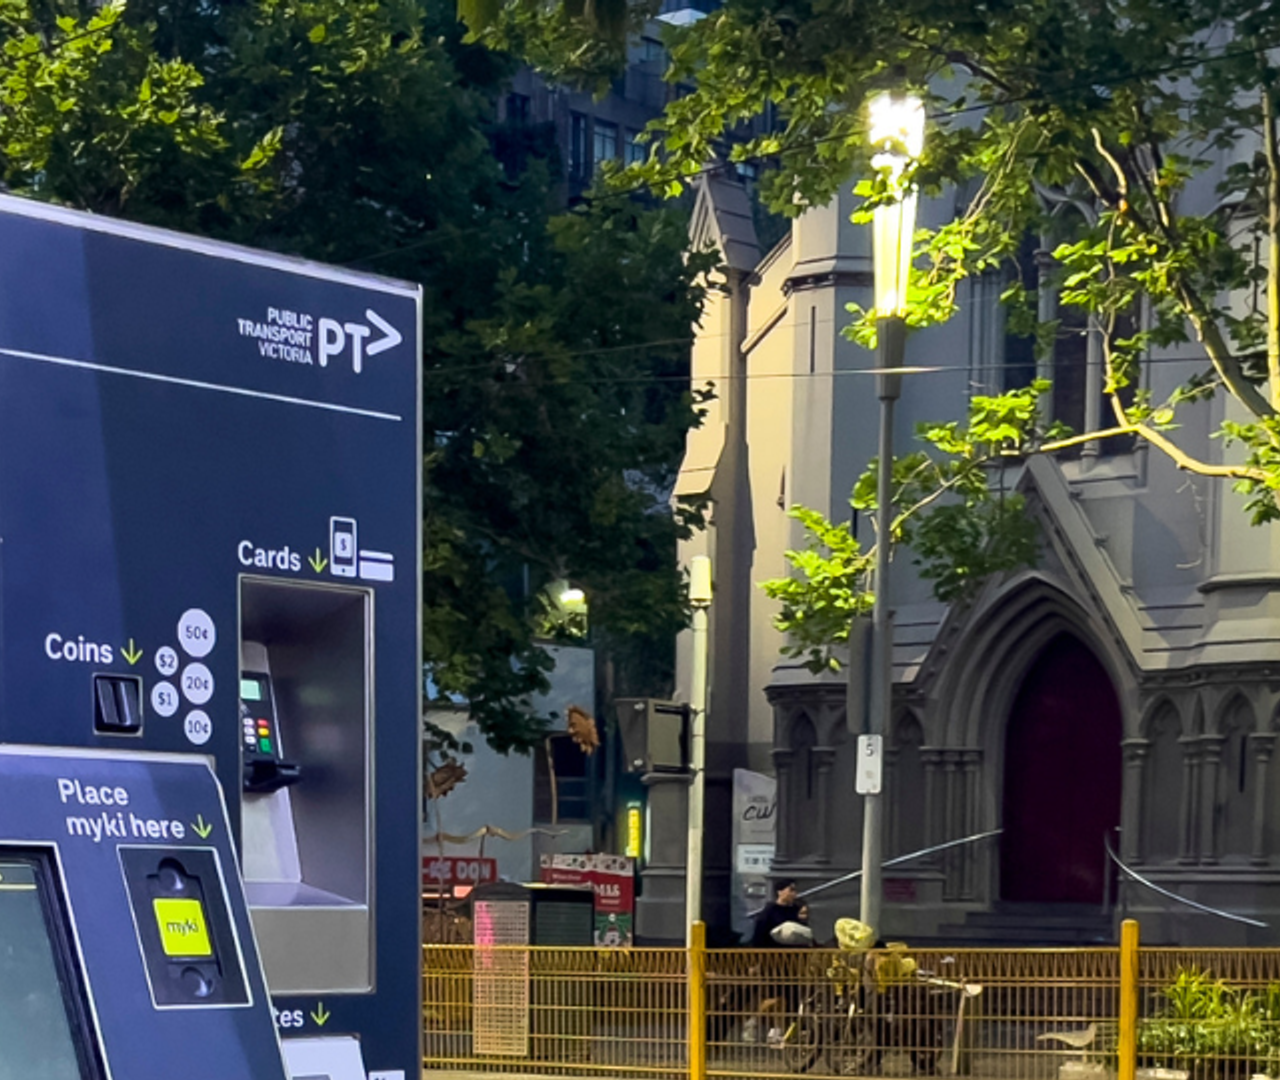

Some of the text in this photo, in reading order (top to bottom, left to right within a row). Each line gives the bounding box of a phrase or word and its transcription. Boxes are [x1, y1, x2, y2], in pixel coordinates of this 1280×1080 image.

[267, 306, 313, 331] PUBLIC
[236, 318, 313, 347] TRANSPORT
[257, 340, 313, 365] VICTORIA
[237, 540, 301, 571] Cards
[44, 632, 114, 664] Coins
[158, 653, 175, 669] $2
[157, 691, 172, 706] $1
[58, 778, 129, 805] Place
[66, 812, 186, 843] myki here
[166, 918, 199, 936] myki
